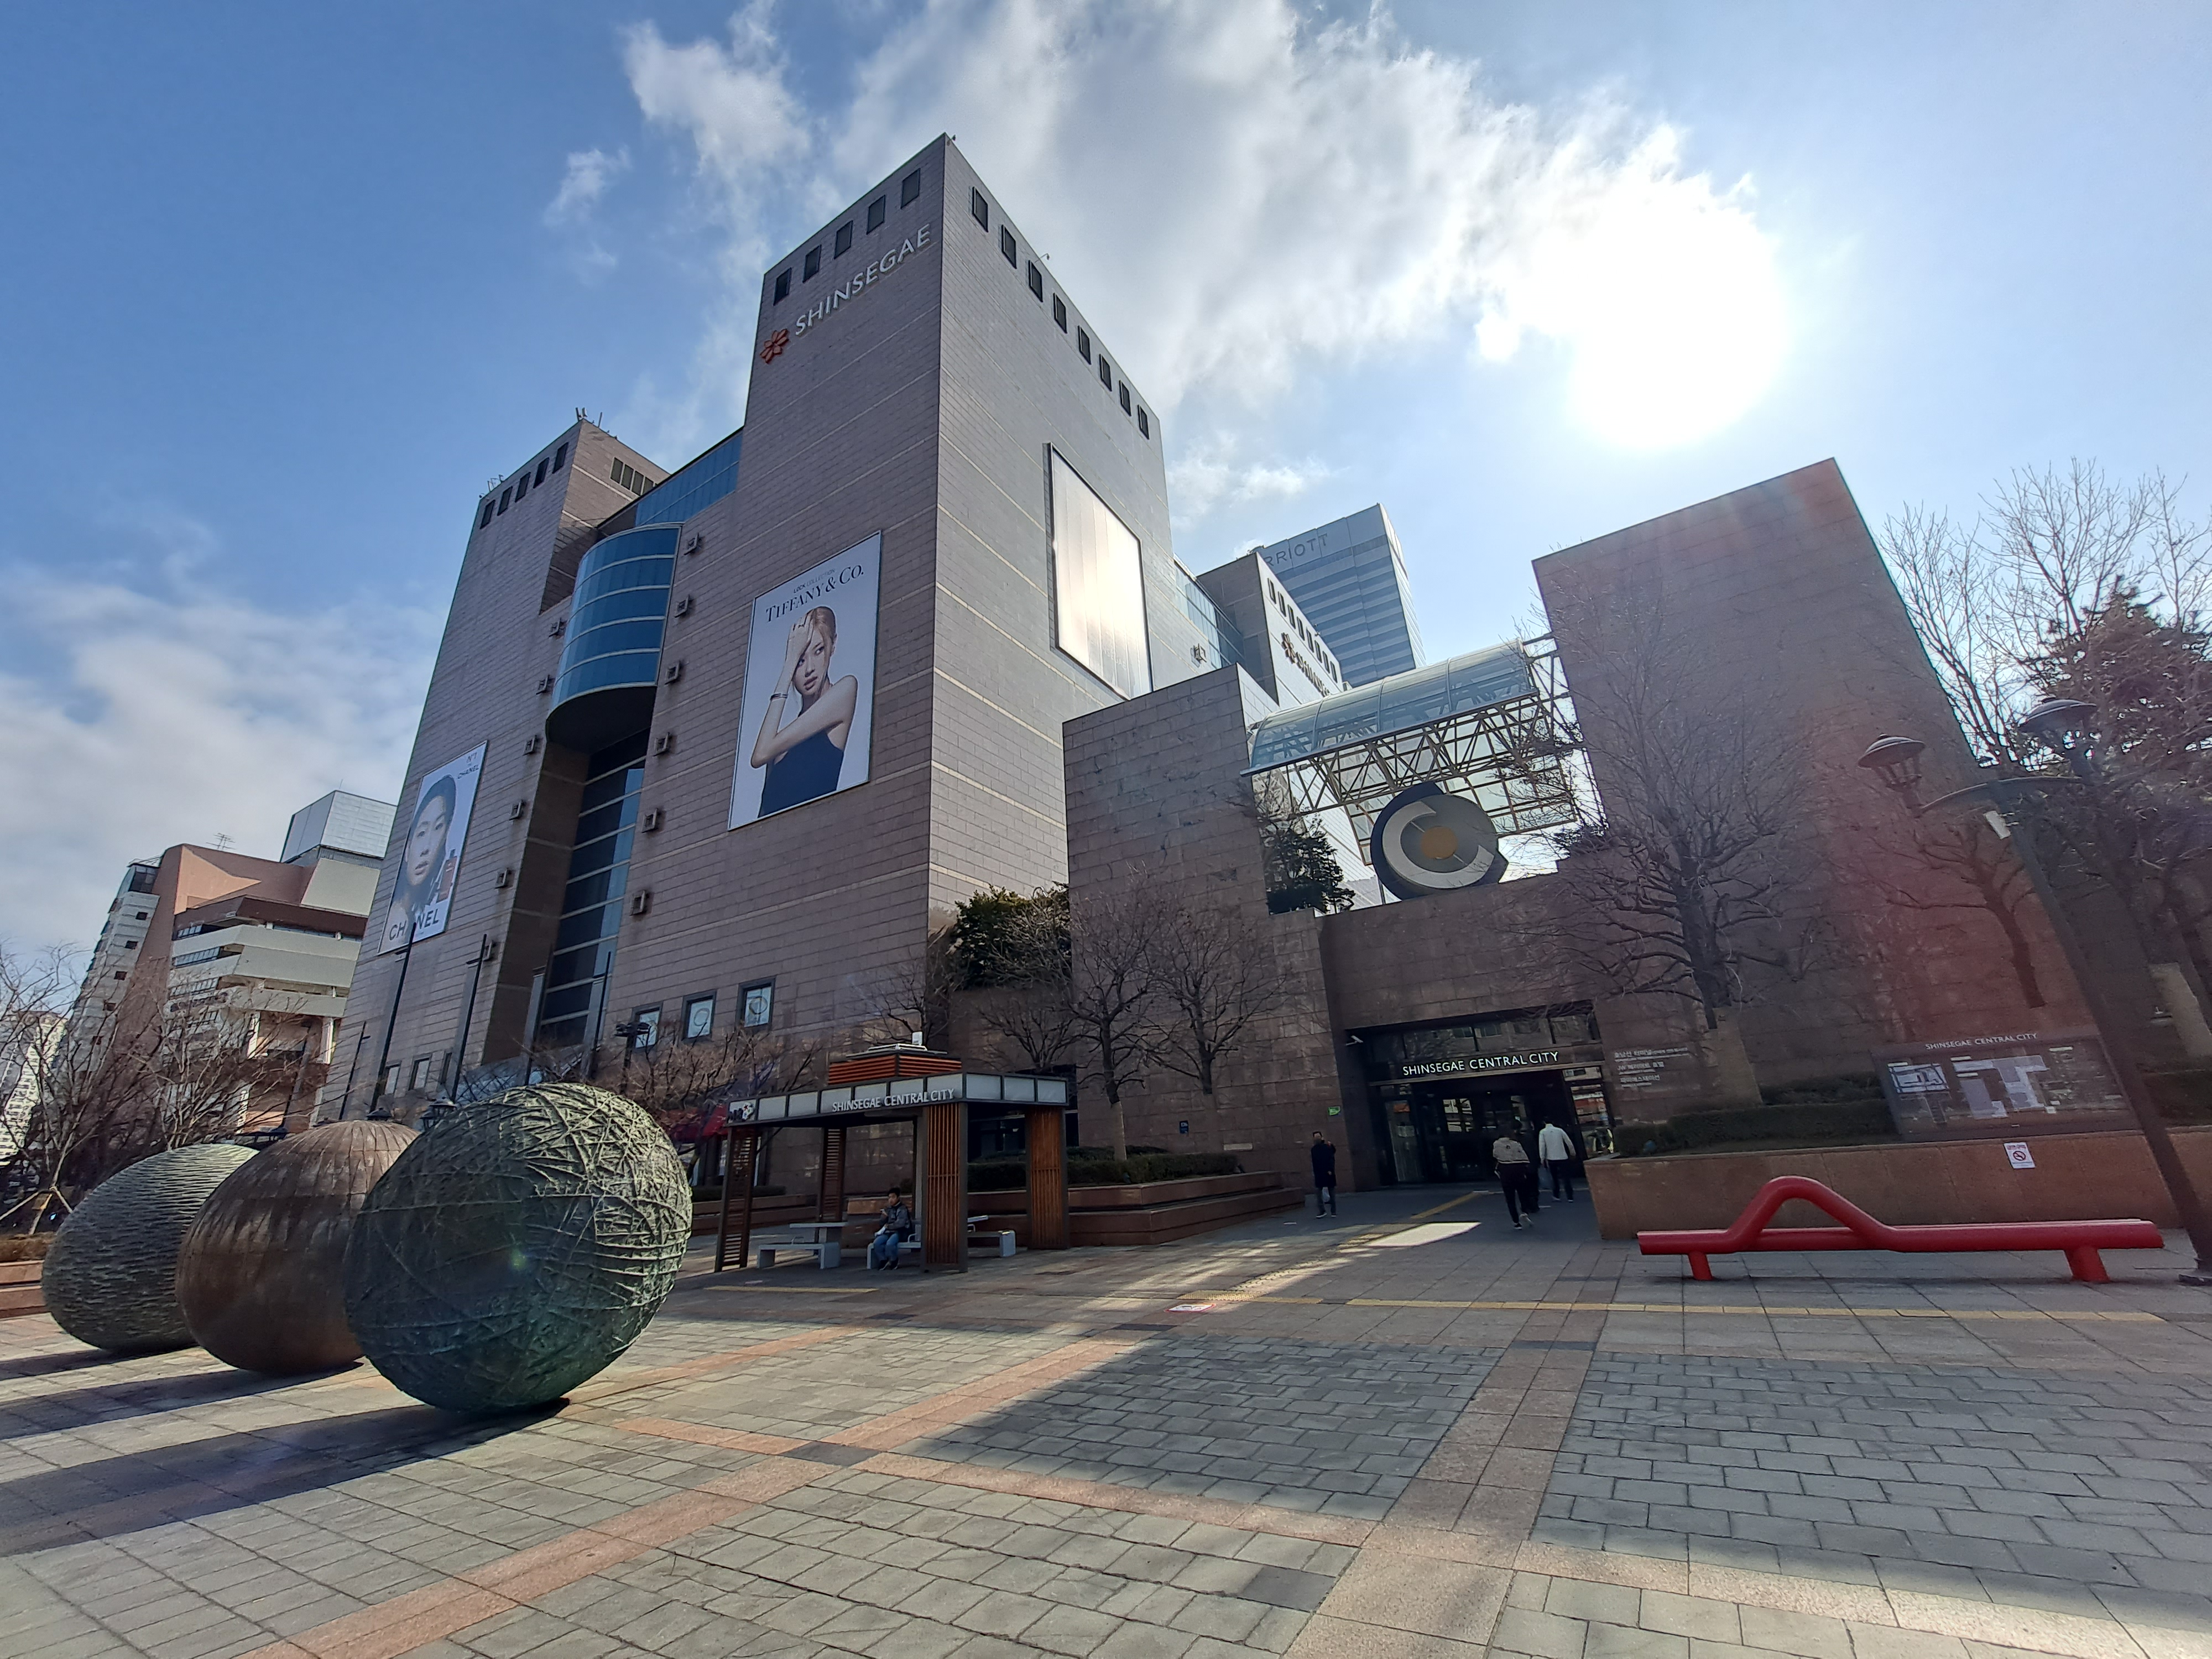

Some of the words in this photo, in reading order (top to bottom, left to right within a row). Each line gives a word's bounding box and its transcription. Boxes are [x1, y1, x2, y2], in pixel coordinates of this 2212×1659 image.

[796, 224, 930, 336] SHINSEGAE
[1264, 533, 1328, 566] RRIOTT
[766, 583, 824, 622] TIFFANY
[389, 909, 439, 941] CHNEL
[1925, 1039, 1972, 1050] SHINSEGAE
[1974, 1036, 2016, 1045] CENTRAL
[1402, 1061, 1465, 1076] SHINSEGAE
[1469, 1055, 1527, 1070] CENTRAL
[1528, 1051, 1559, 1063] CITY
[832, 1097, 881, 1112] SHINSEGAE
[884, 1091, 930, 1106] CENTRAL
[930, 1088, 955, 1101] CITY
